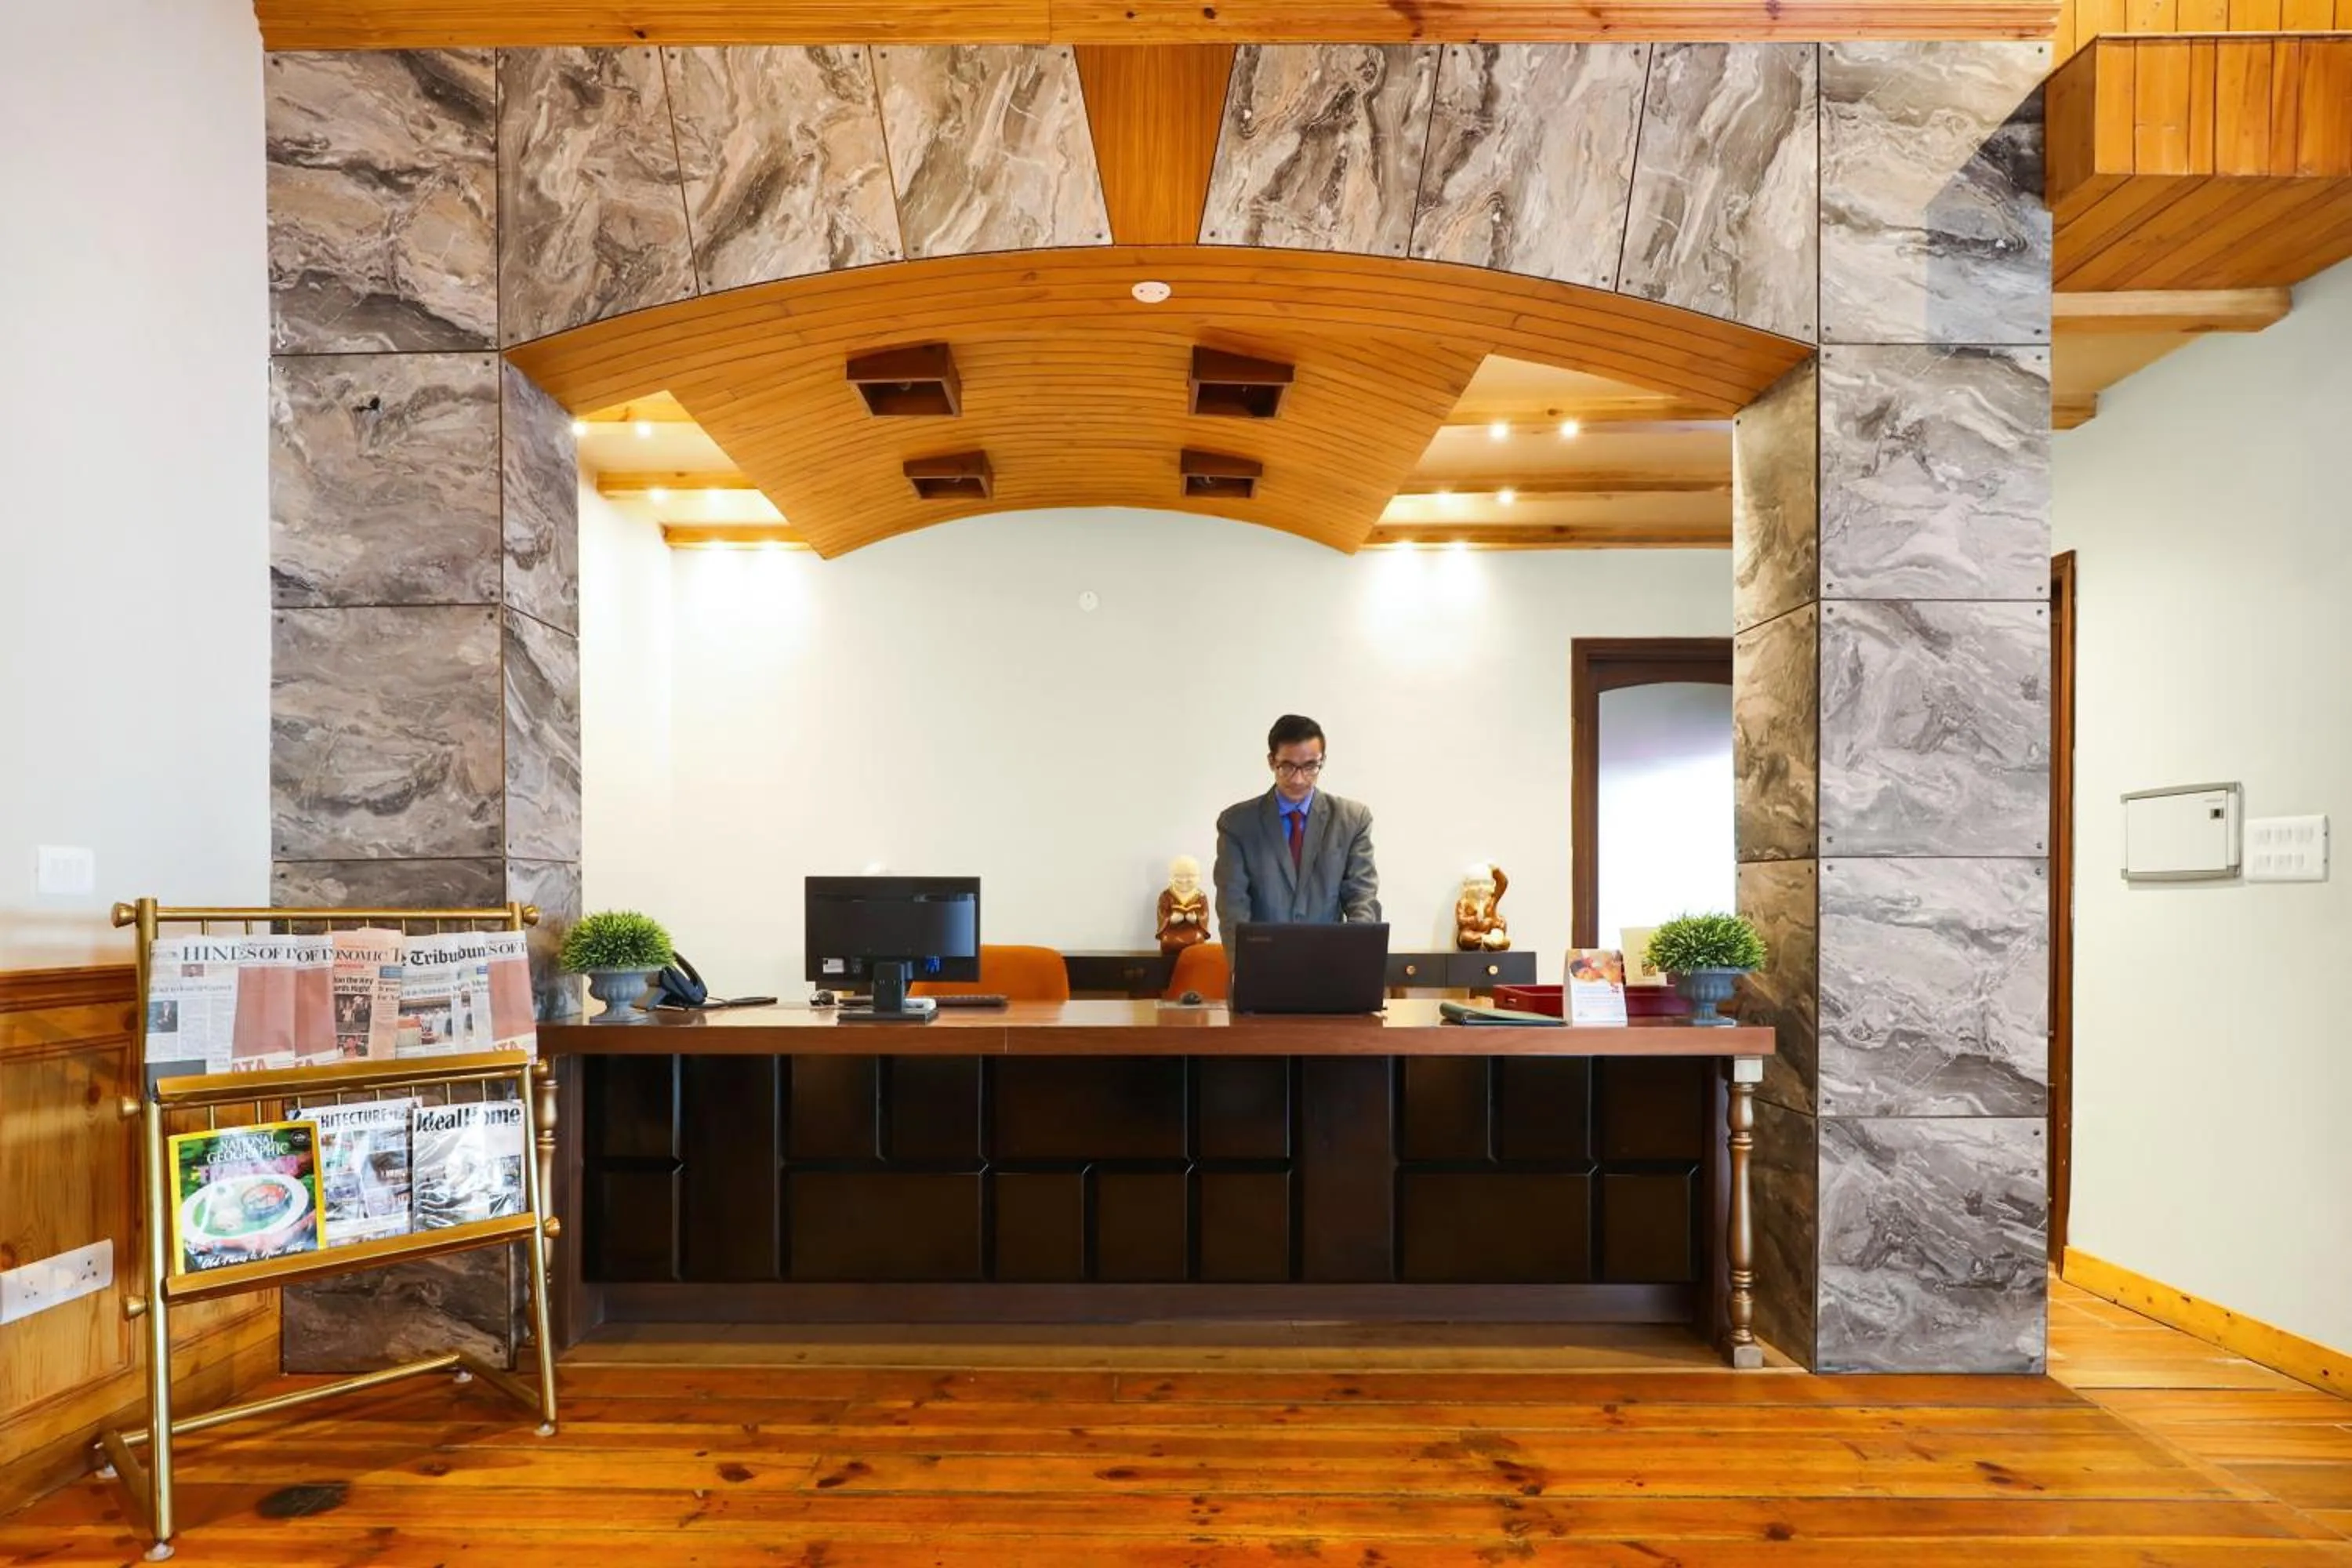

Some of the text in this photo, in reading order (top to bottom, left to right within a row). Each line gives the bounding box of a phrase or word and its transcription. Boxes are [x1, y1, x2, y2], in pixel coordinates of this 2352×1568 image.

[260, 946, 283, 960] OF
[297, 949, 318, 963] OF
[416, 1108, 462, 1133] Ideal
[220, 1132, 274, 1150] NATIONAL
[206, 1142, 290, 1165] GEOGRAPHIC
